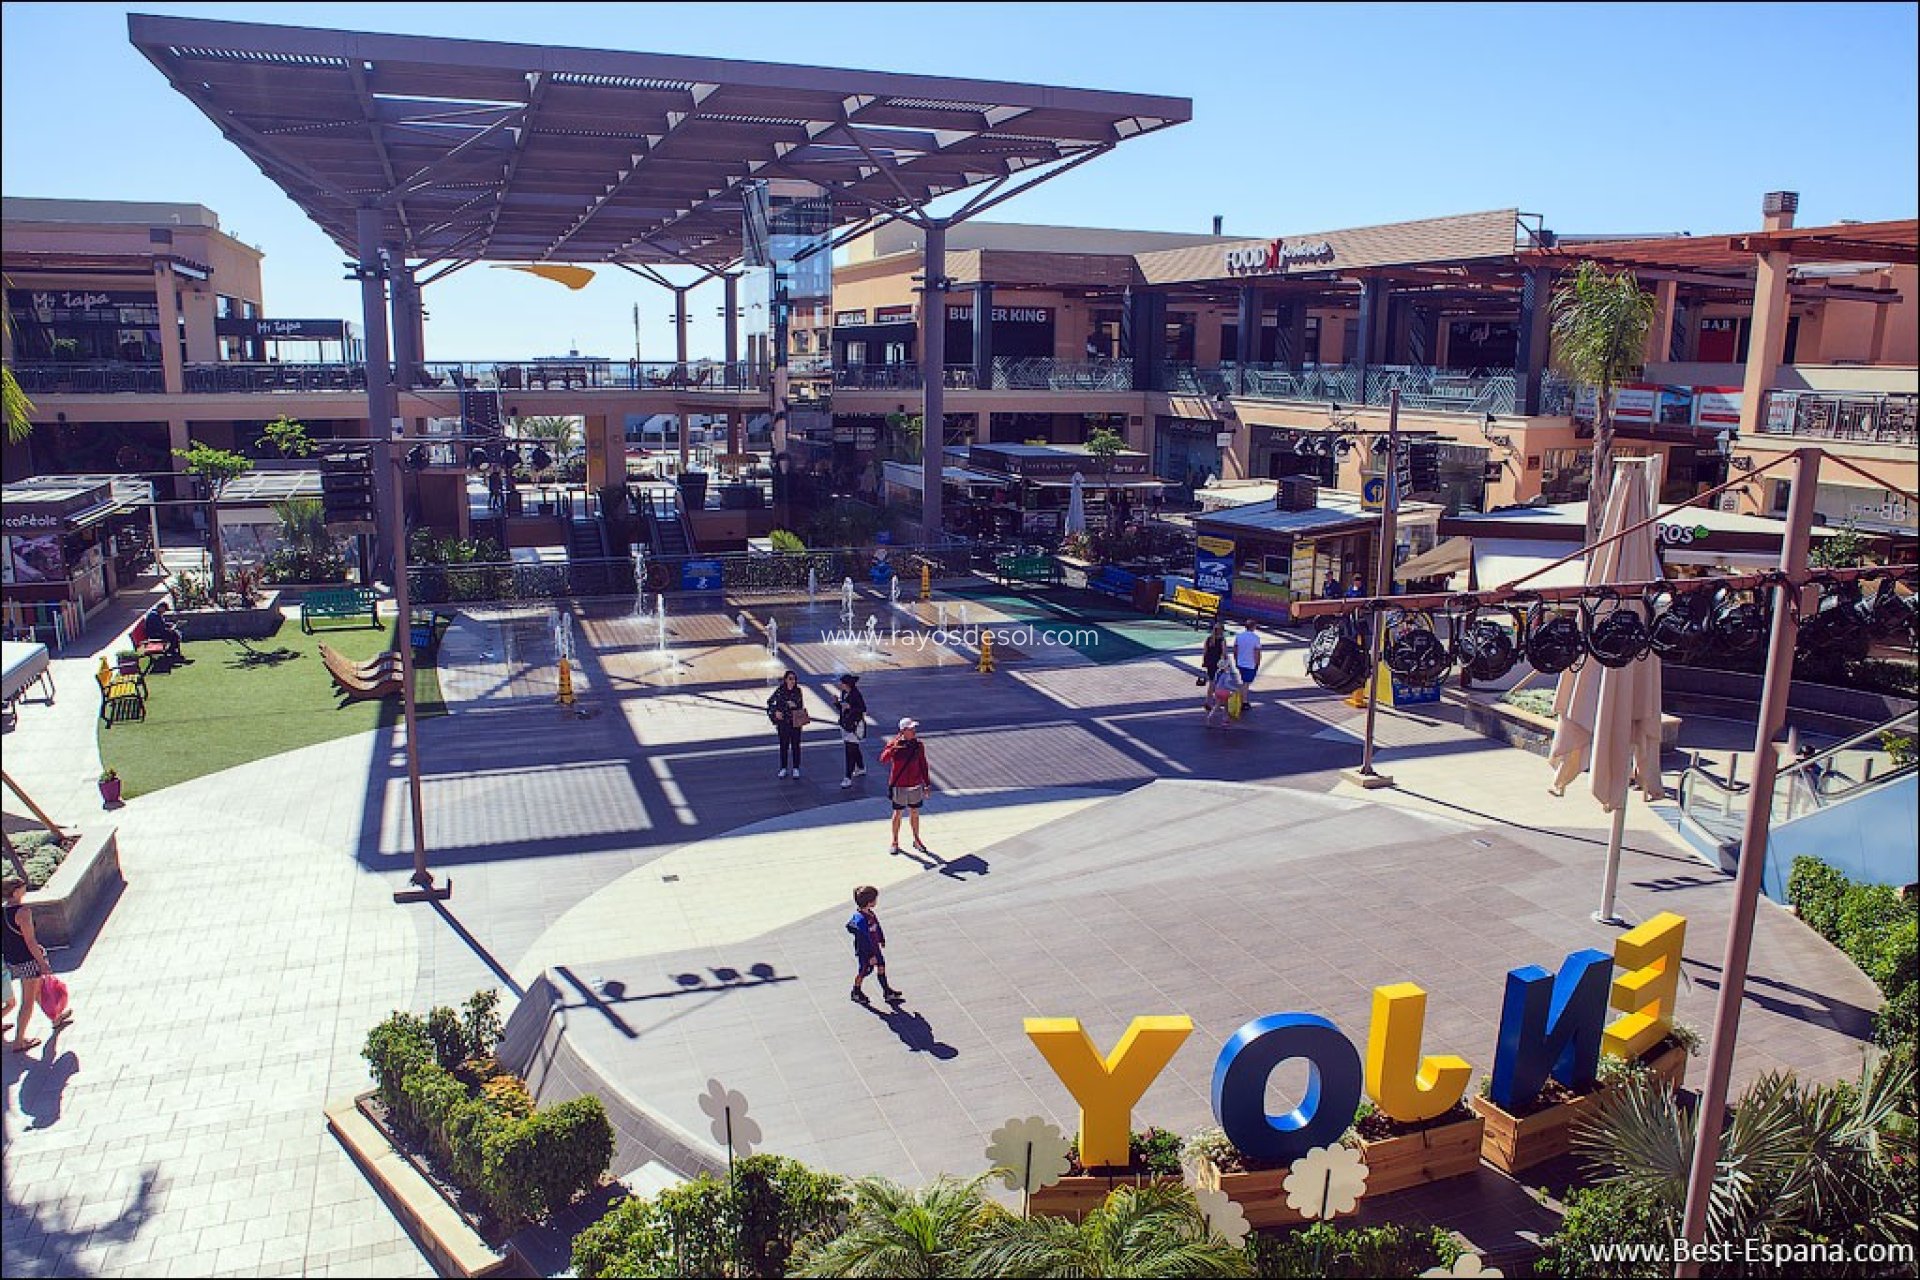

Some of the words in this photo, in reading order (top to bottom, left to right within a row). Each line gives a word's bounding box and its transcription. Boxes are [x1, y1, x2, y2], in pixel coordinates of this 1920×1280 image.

[1224, 248, 1266, 269] FOOD
[950, 307, 1007, 321] BUER
[1010, 308, 1047, 323] KING
